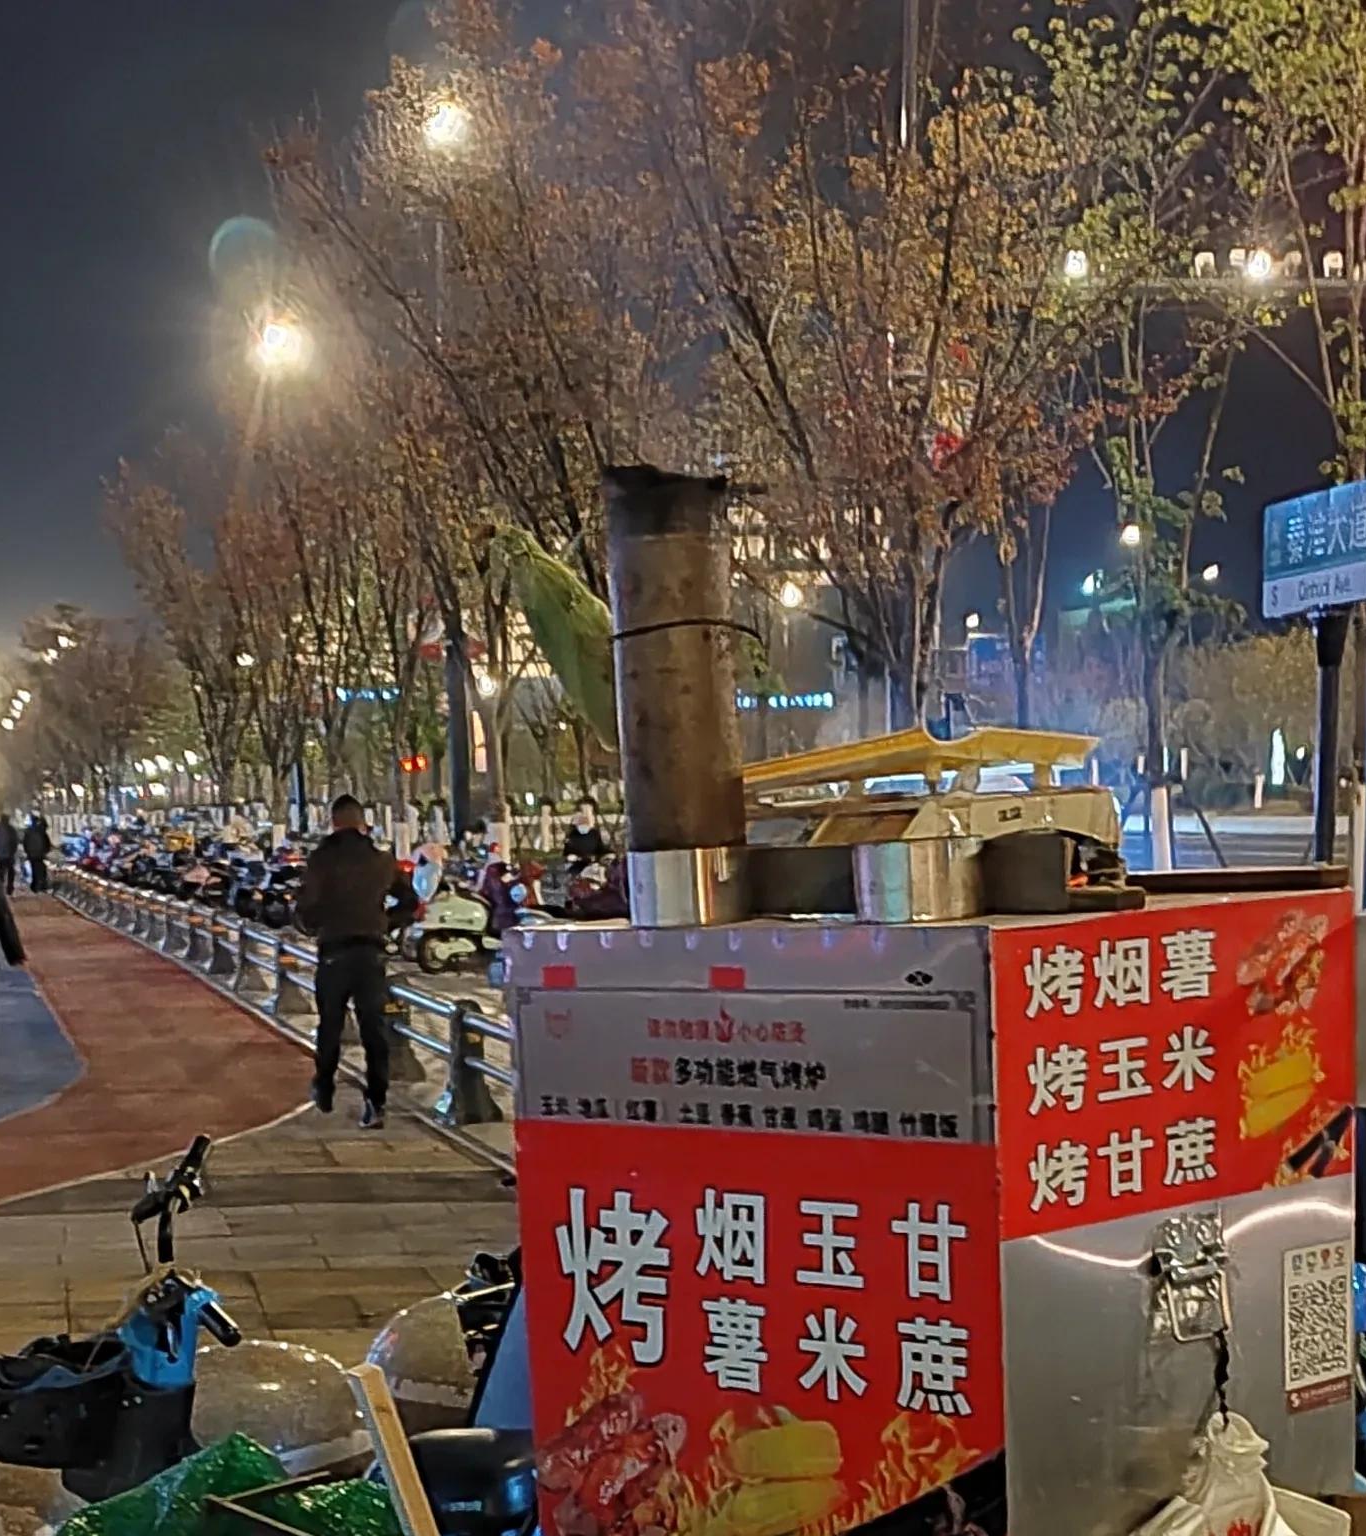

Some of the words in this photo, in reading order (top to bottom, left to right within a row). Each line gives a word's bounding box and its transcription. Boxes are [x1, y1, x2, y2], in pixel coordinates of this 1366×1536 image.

[1024, 929, 1218, 1019] 烤烟薯
[1026, 1024, 1217, 1117] 烤玉米
[1028, 1119, 1218, 1214] 烤甘蔗
[556, 1186, 673, 1367] 烤
